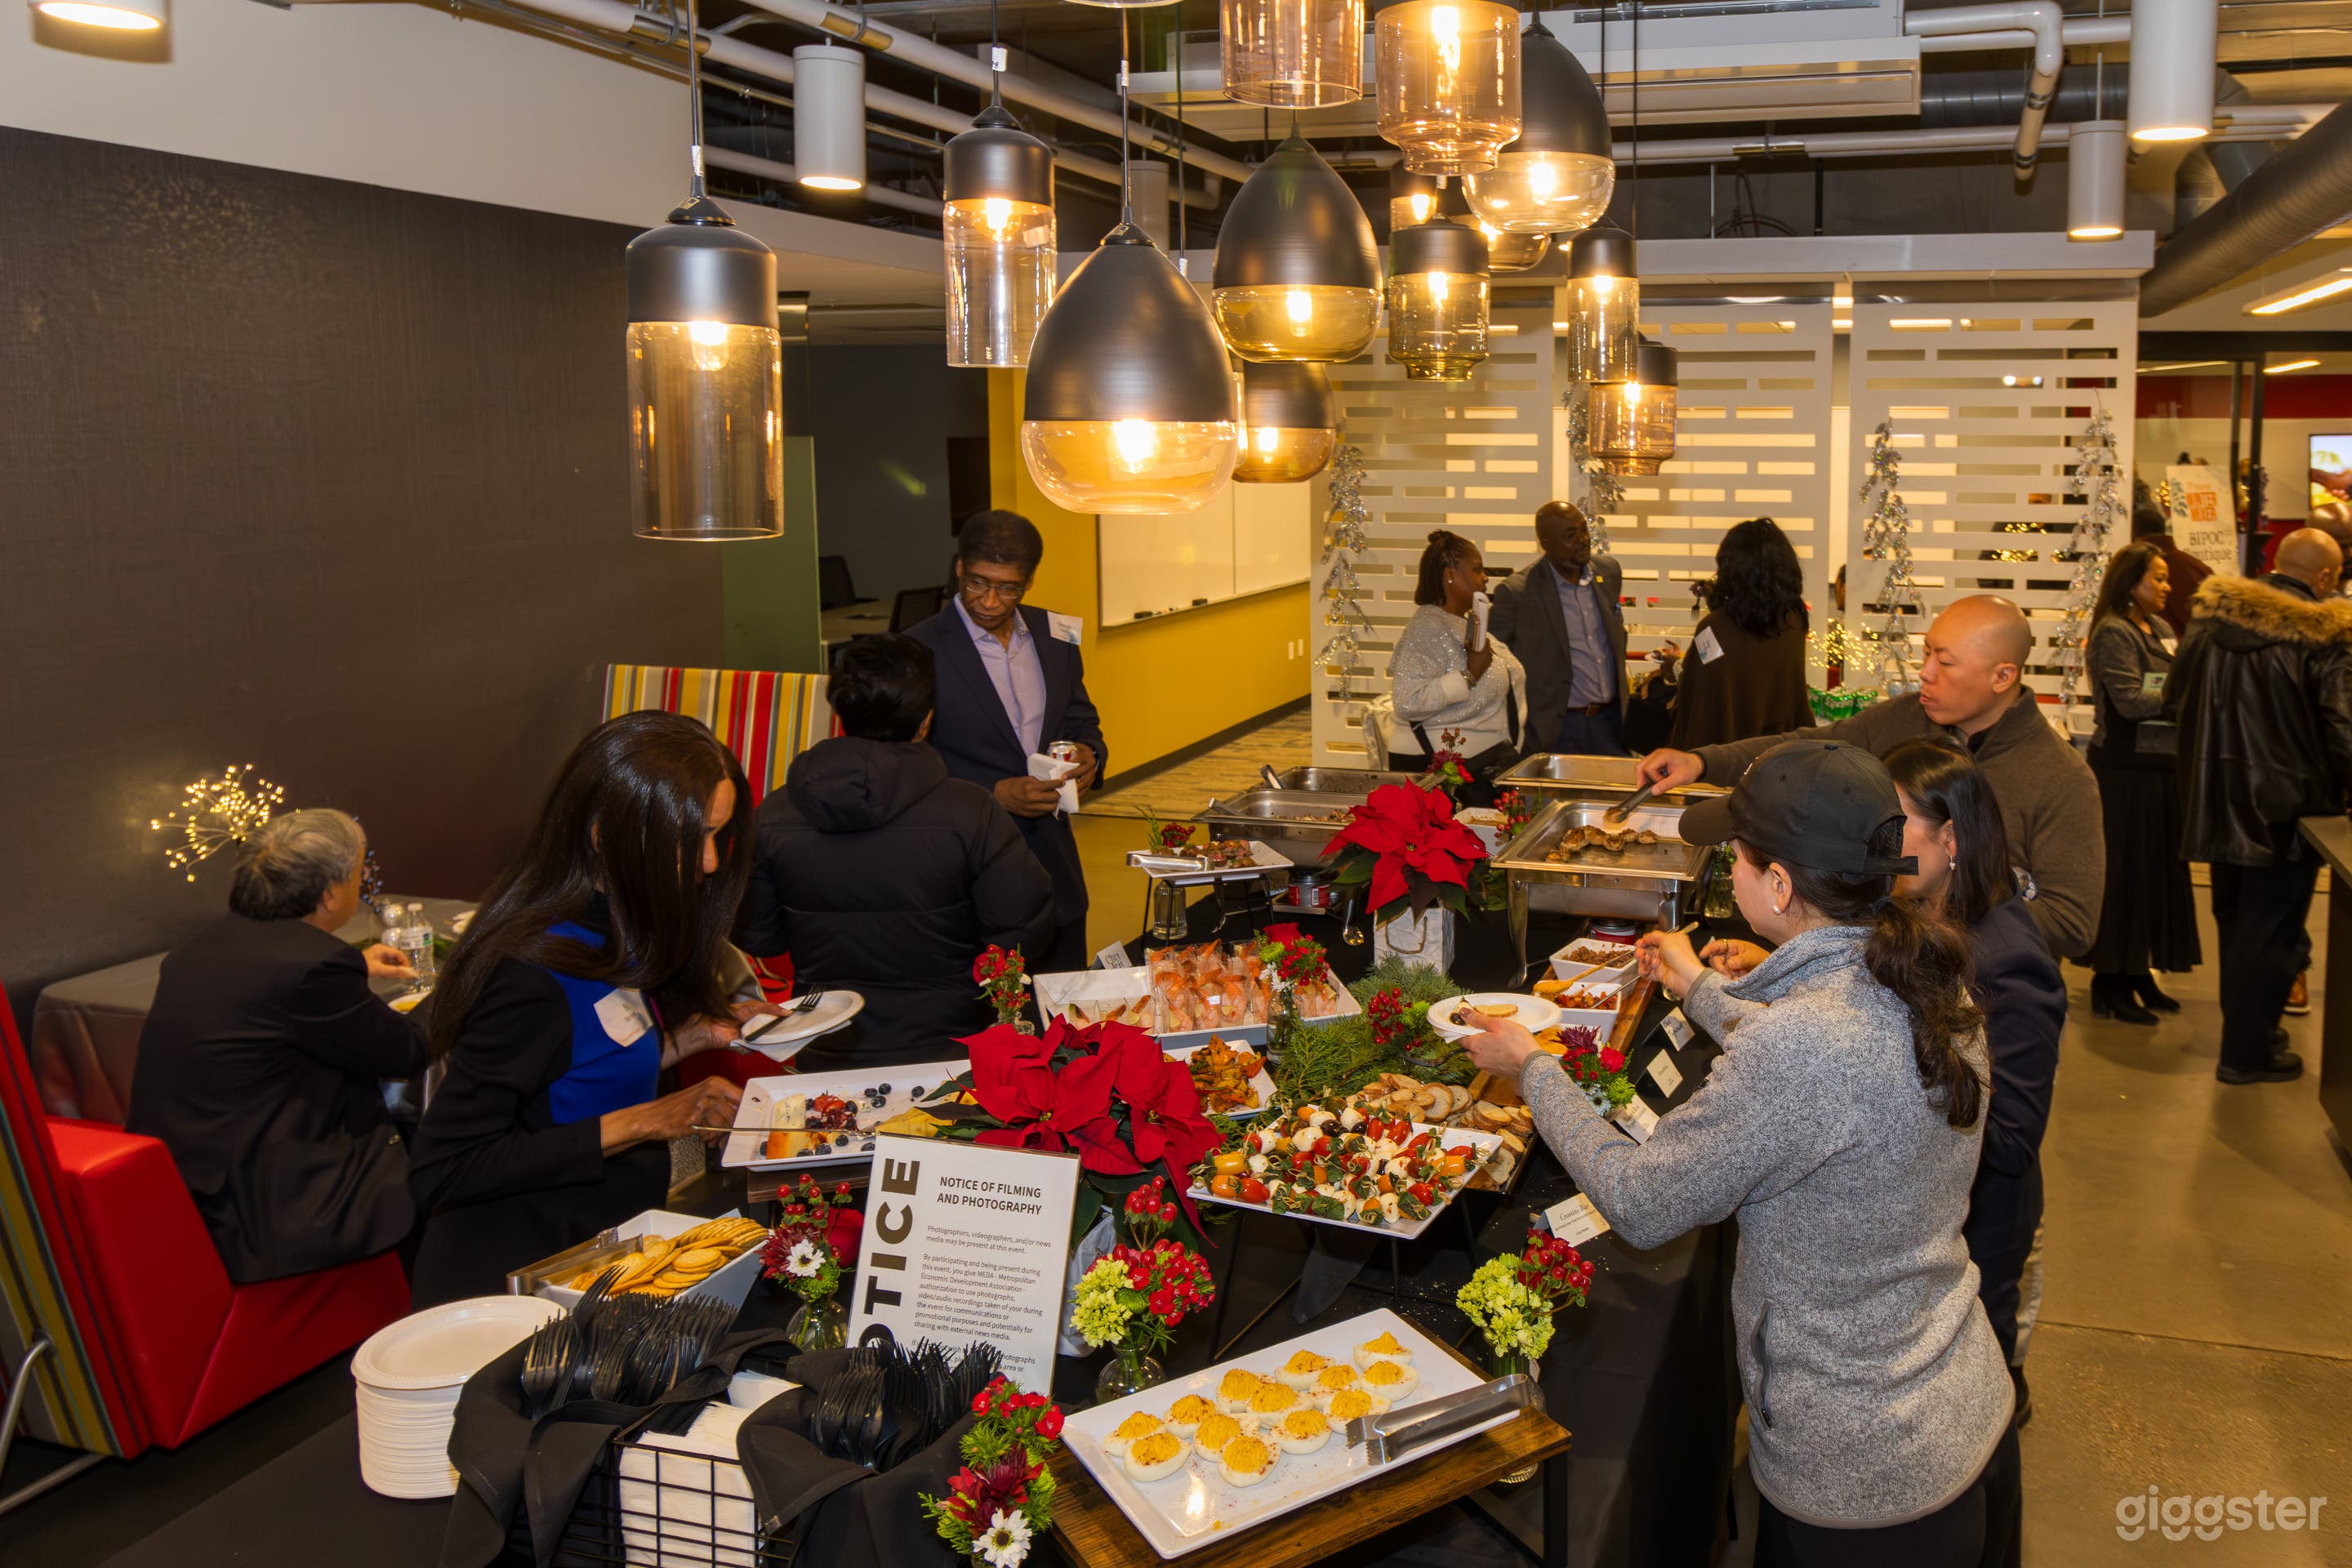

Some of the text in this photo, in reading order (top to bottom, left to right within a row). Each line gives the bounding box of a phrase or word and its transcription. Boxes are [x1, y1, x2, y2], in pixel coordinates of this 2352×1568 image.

[2189, 531, 2223, 546] BIPOC
[939, 1176, 1040, 1198] NOTICE OF FILMING
[937, 1192, 1041, 1214] AND PHOTOGRAPHY
[927, 1225, 970, 1237] Photographers,
[971, 1232, 1013, 1244] videographers,
[944, 1237, 958, 1245] may
[922, 1263, 933, 1271] this
[933, 1266, 951, 1274] event,
[951, 1267, 964, 1275] you
[977, 1271, 993, 1279] MEDA
[998, 1273, 1036, 1284] Metropolitan
[923, 1254, 931, 1262] By
[931, 1256, 968, 1267] participating
[980, 1261, 997, 1271] being
[997, 1263, 1021, 1272] present
[1021, 1267, 1040, 1276] during
[920, 1272, 949, 1282] Economic
[949, 1276, 989, 1288] Development
[989, 1282, 1022, 1293] Association
[920, 1283, 958, 1293] authorization
[976, 1290, 1015, 1303] photographs,
[918, 1292, 952, 1303] video/audio
[952, 1298, 983, 1308] recordings
[984, 1301, 1000, 1310] taken
[1022, 1306, 1043, 1316] during
[953, 1307, 1001, 1319] communications
[914, 1321, 936, 1330] sharing
[950, 1326, 973, 1334] external
[915, 1312, 951, 1321] promotional
[951, 1316, 979, 1327] purposes
[991, 1322, 1023, 1333] potentially
